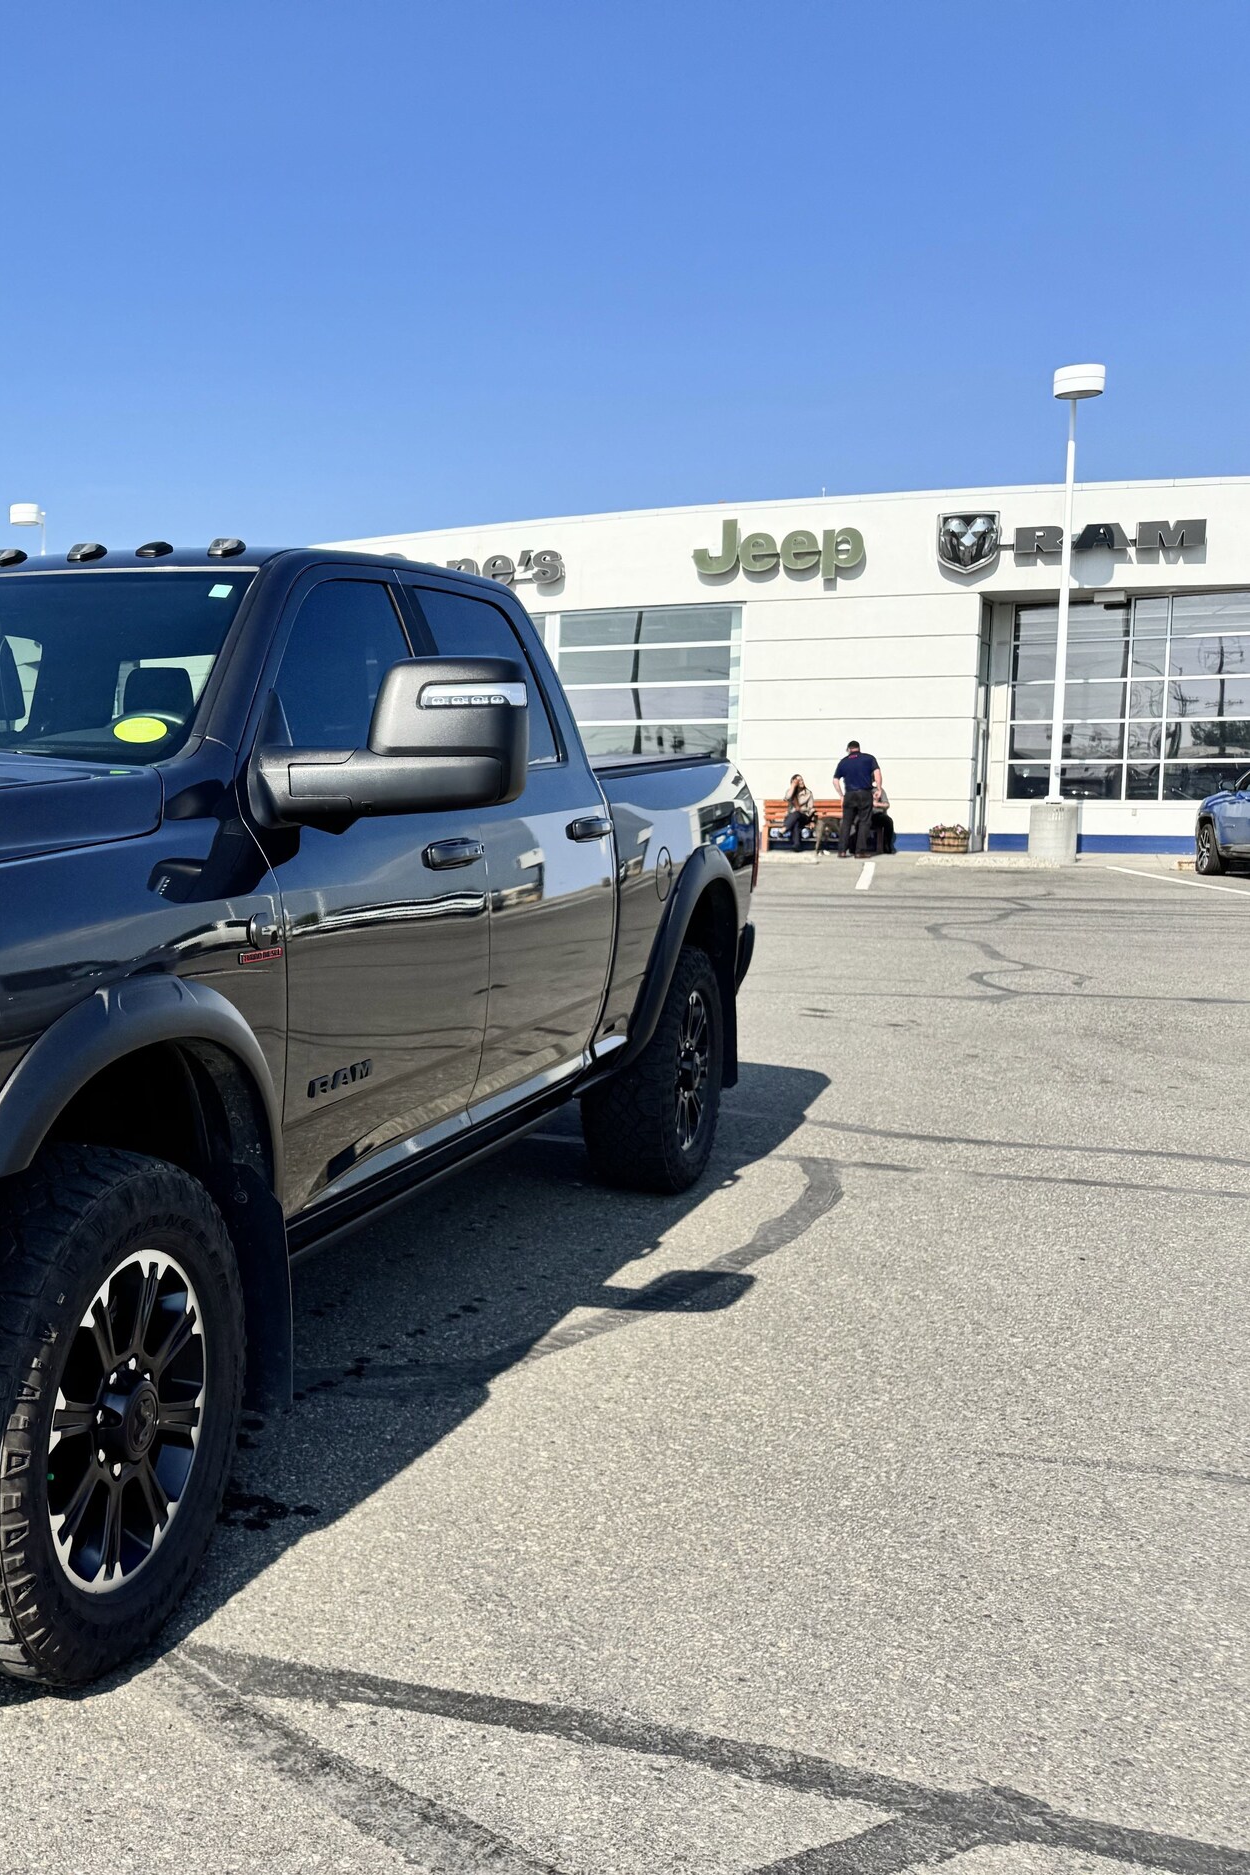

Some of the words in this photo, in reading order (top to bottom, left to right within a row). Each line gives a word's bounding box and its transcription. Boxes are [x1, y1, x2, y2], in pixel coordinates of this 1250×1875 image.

[693, 518, 865, 579] Jeep
[1013, 518, 1208, 554] RAM
[307, 1058, 373, 1098] RAM
